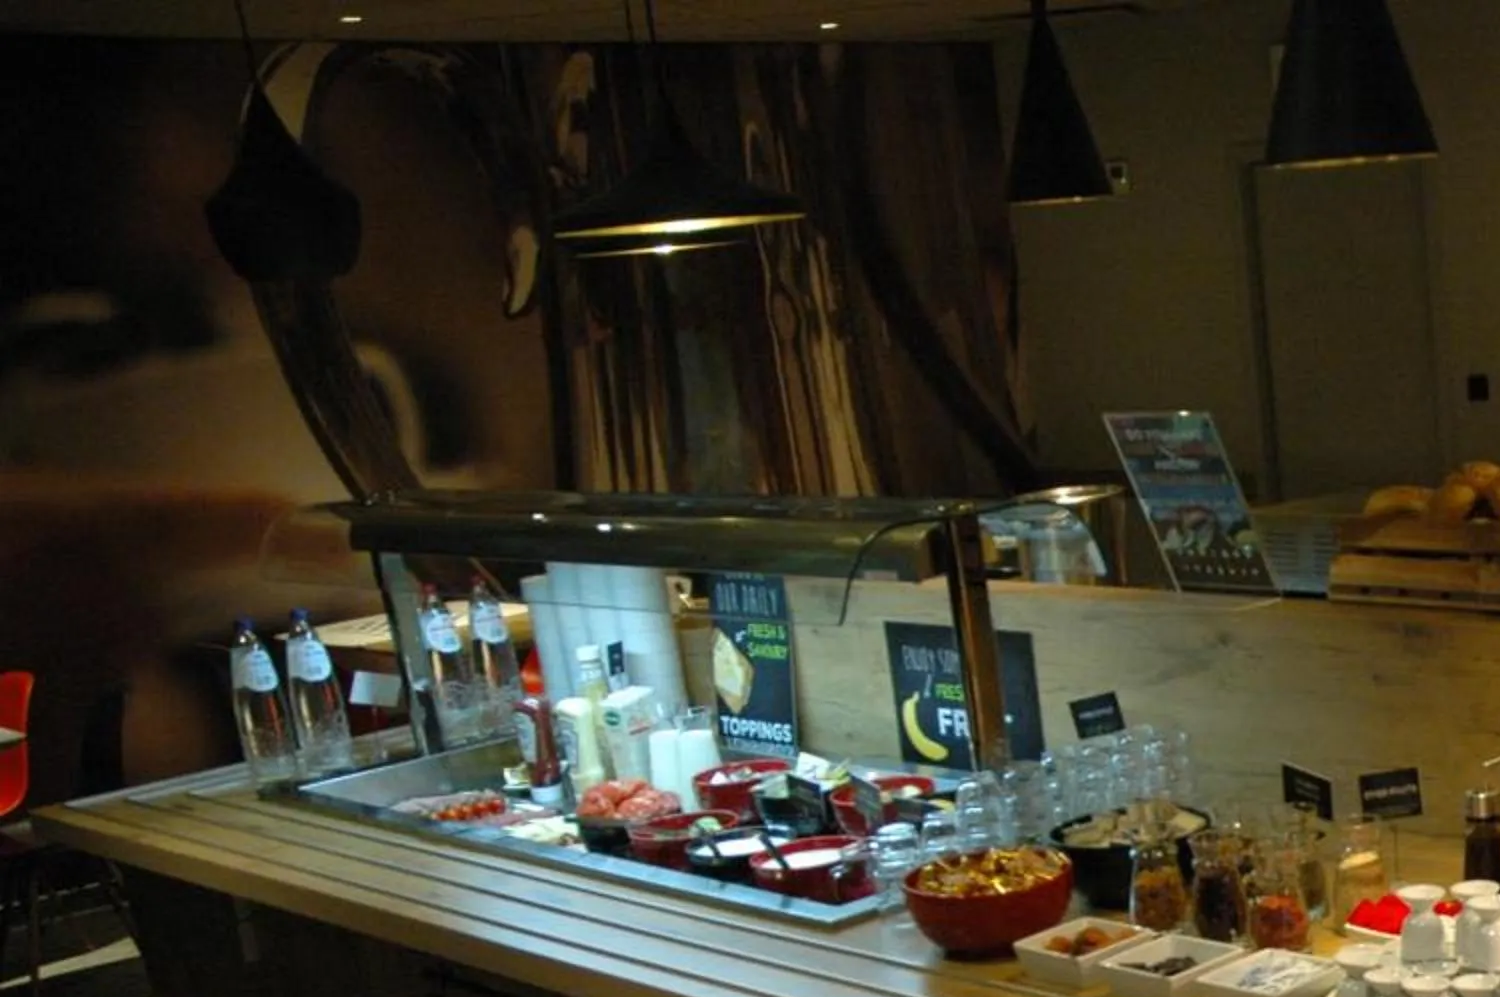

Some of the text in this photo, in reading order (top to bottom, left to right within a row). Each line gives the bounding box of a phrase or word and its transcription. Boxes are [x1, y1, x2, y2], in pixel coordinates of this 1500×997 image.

[747, 623, 777, 639] FRESH
[934, 683, 965, 702] FRES
[720, 715, 792, 743] TOPPINGS
